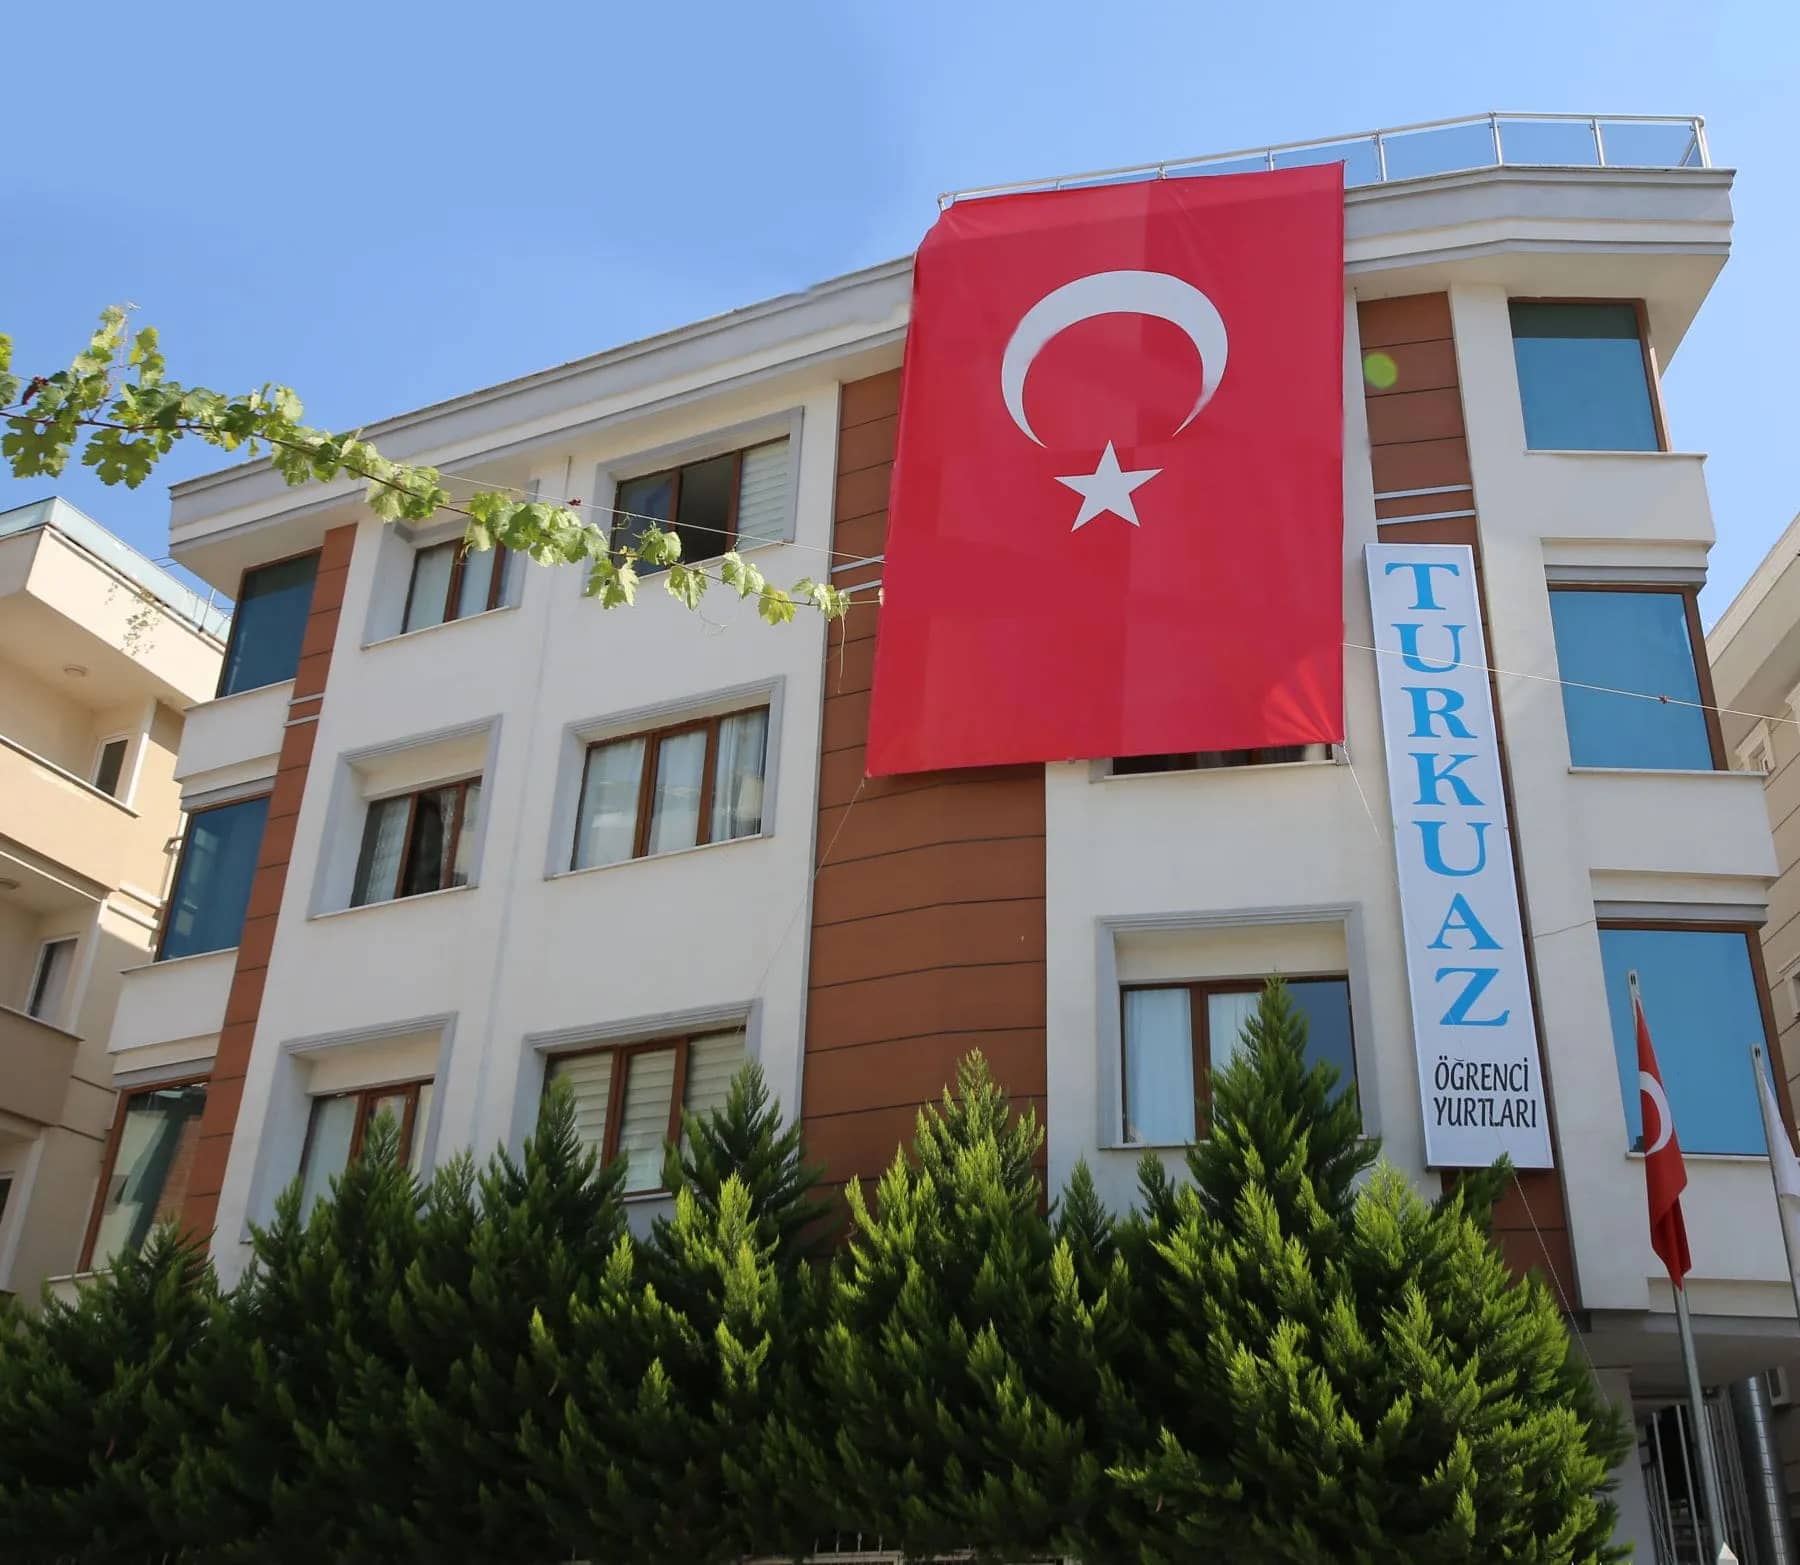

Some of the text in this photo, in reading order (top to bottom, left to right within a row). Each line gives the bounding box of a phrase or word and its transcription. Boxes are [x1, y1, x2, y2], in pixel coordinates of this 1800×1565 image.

[1384, 562, 1510, 1026] TURKUAZ
[1434, 1055, 1529, 1092] ÖĞRENCİ
[1433, 1096, 1537, 1128] YURTLARI
